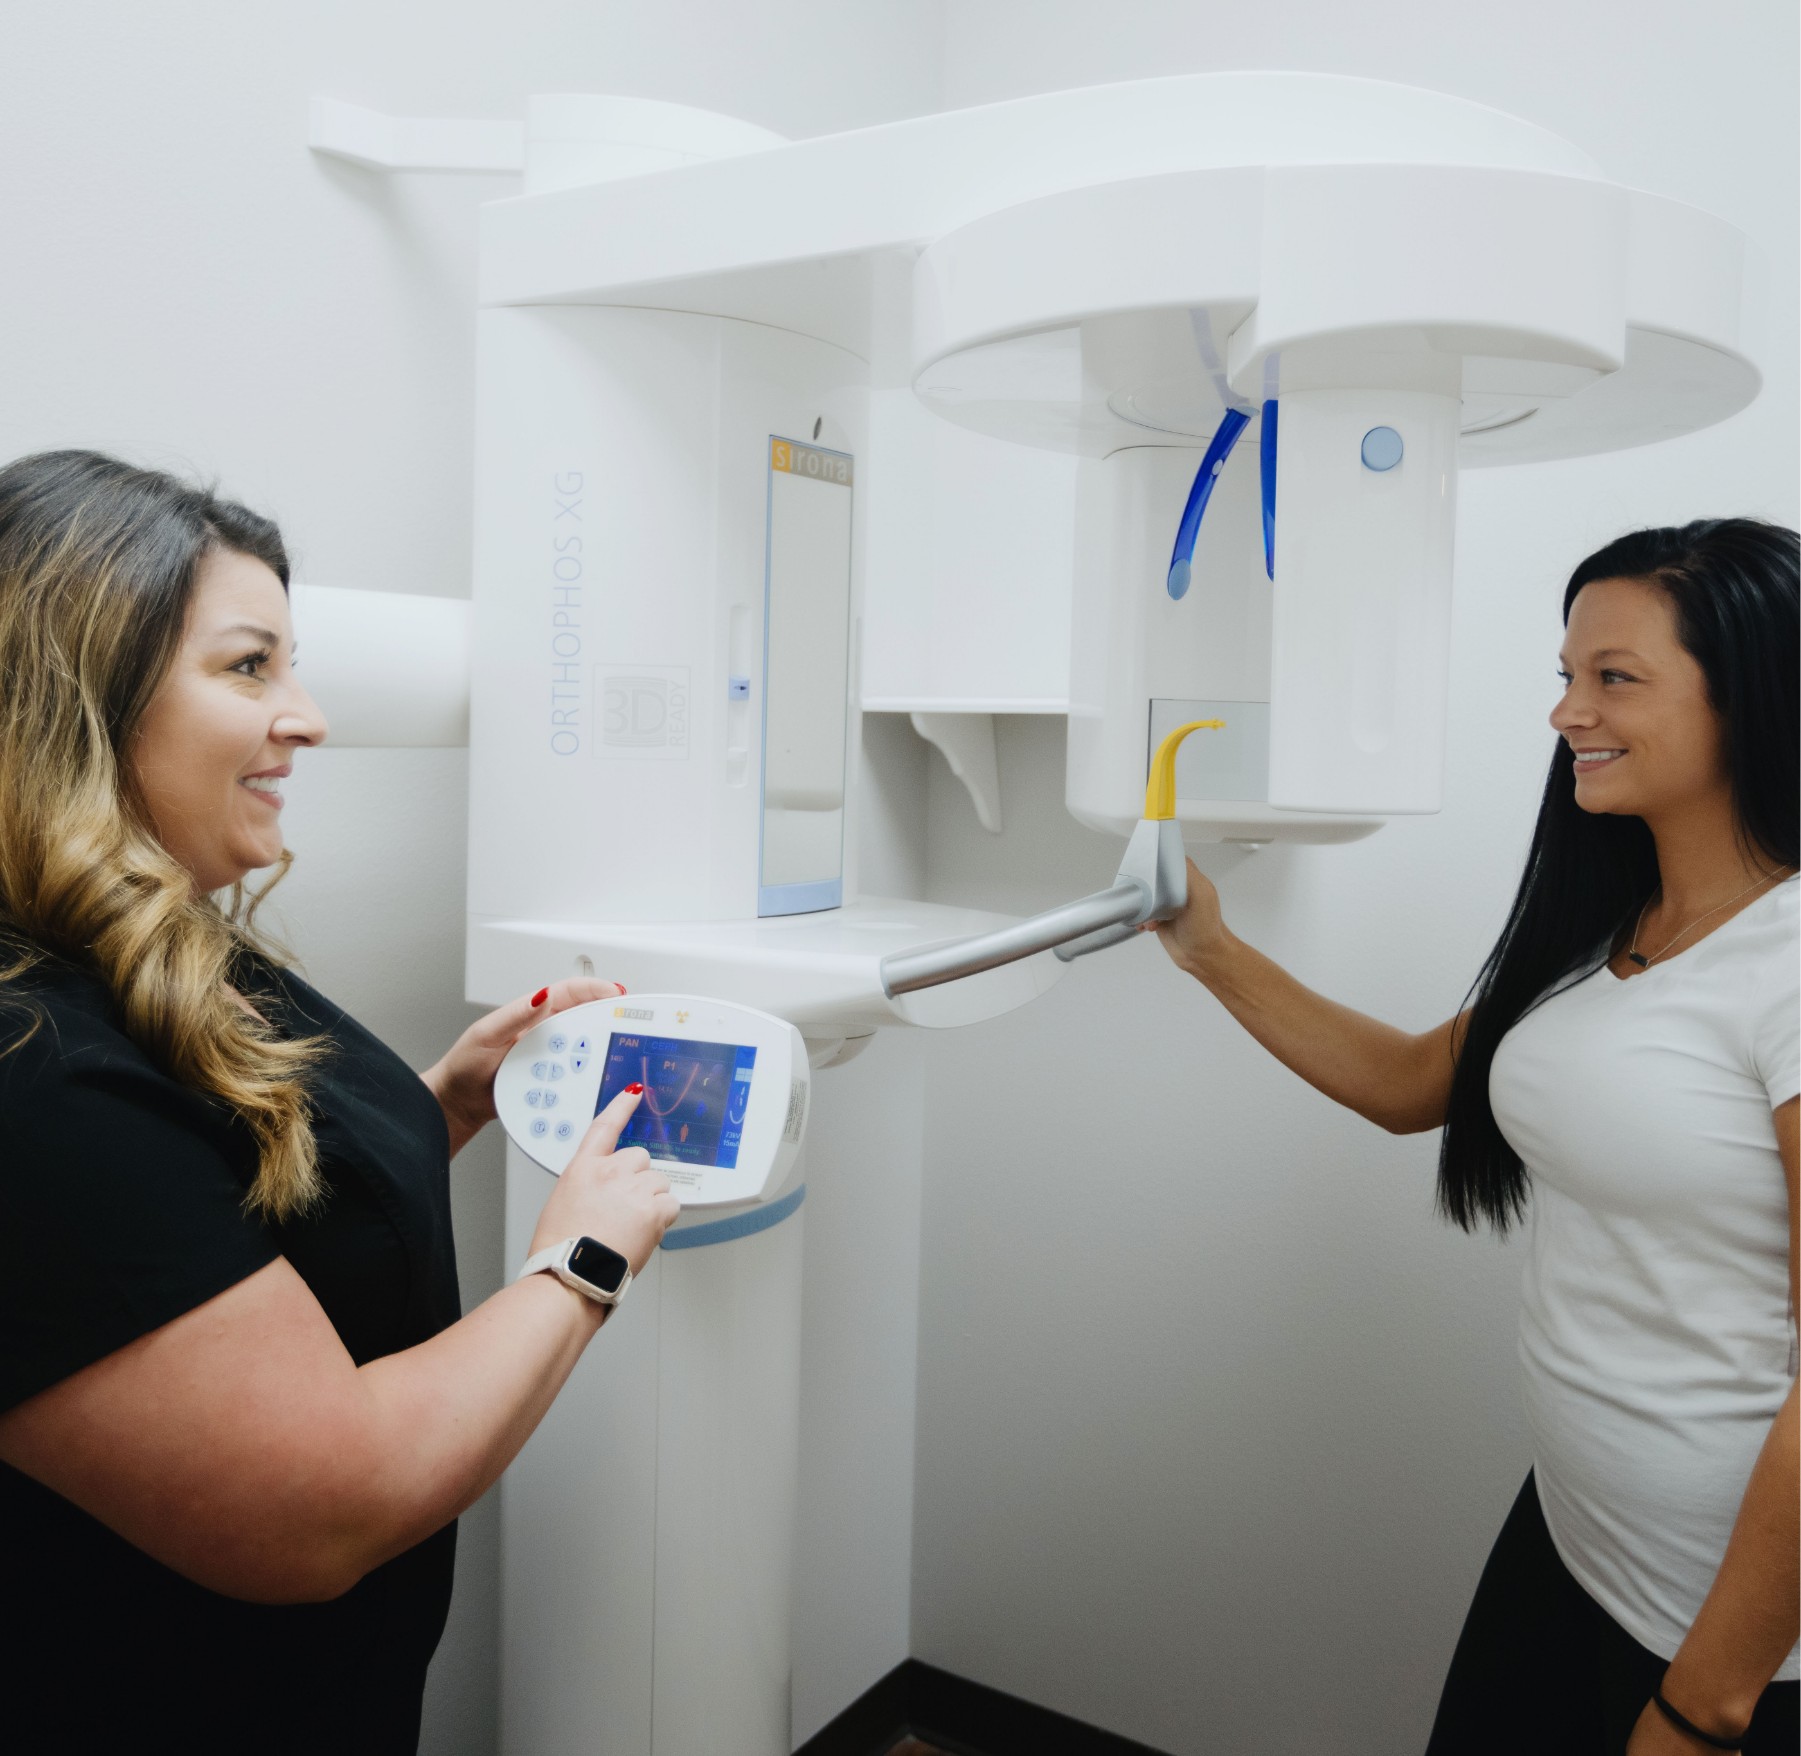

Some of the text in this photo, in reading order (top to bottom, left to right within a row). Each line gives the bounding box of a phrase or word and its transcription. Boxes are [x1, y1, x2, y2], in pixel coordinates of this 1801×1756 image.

[774, 443, 849, 482] sirona
[550, 471, 584, 756] ORTHOPHOS XG
[603, 688, 668, 736] 3D
[668, 680, 687, 747] READY
[614, 1007, 653, 1019] sirona
[618, 1036, 678, 1052] PAN CEPH
[663, 1060, 676, 1071] P1
